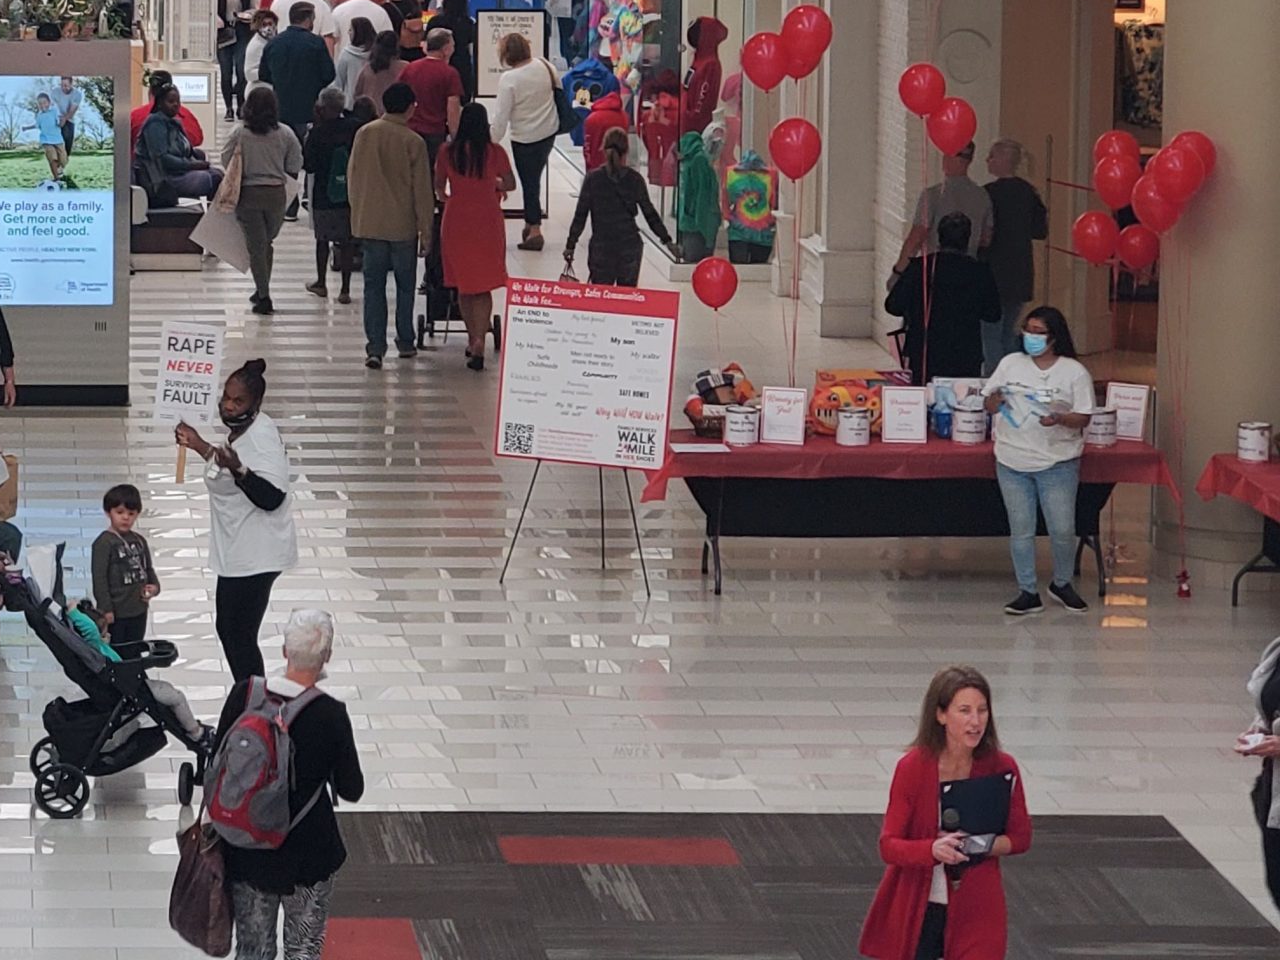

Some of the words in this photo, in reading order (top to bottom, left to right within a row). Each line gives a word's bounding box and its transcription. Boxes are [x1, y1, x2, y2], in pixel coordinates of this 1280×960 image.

[14, 201, 38, 213] play
[41, 202, 54, 211] as
[57, 203, 64, 211] a
[68, 201, 104, 213] family.
[3, 214, 24, 224] Get
[27, 214, 56, 224] more
[59, 214, 94, 224] active
[7, 226, 29, 236] and
[32, 226, 53, 236] feel
[56, 226, 90, 238] good.
[603, 291, 645, 302] Communities
[528, 309, 541, 317] END
[525, 317, 553, 325] violence
[167, 336, 216, 355] RAPE
[610, 336, 620, 346] My
[166, 359, 213, 375] NEVER
[164, 379, 211, 390] SURVIVOR'S
[162, 389, 210, 406] FAULT
[633, 390, 650, 399] HOMES
[618, 430, 656, 445] WALK
[627, 445, 656, 456] MILE
[636, 455, 655, 463] SHOES
